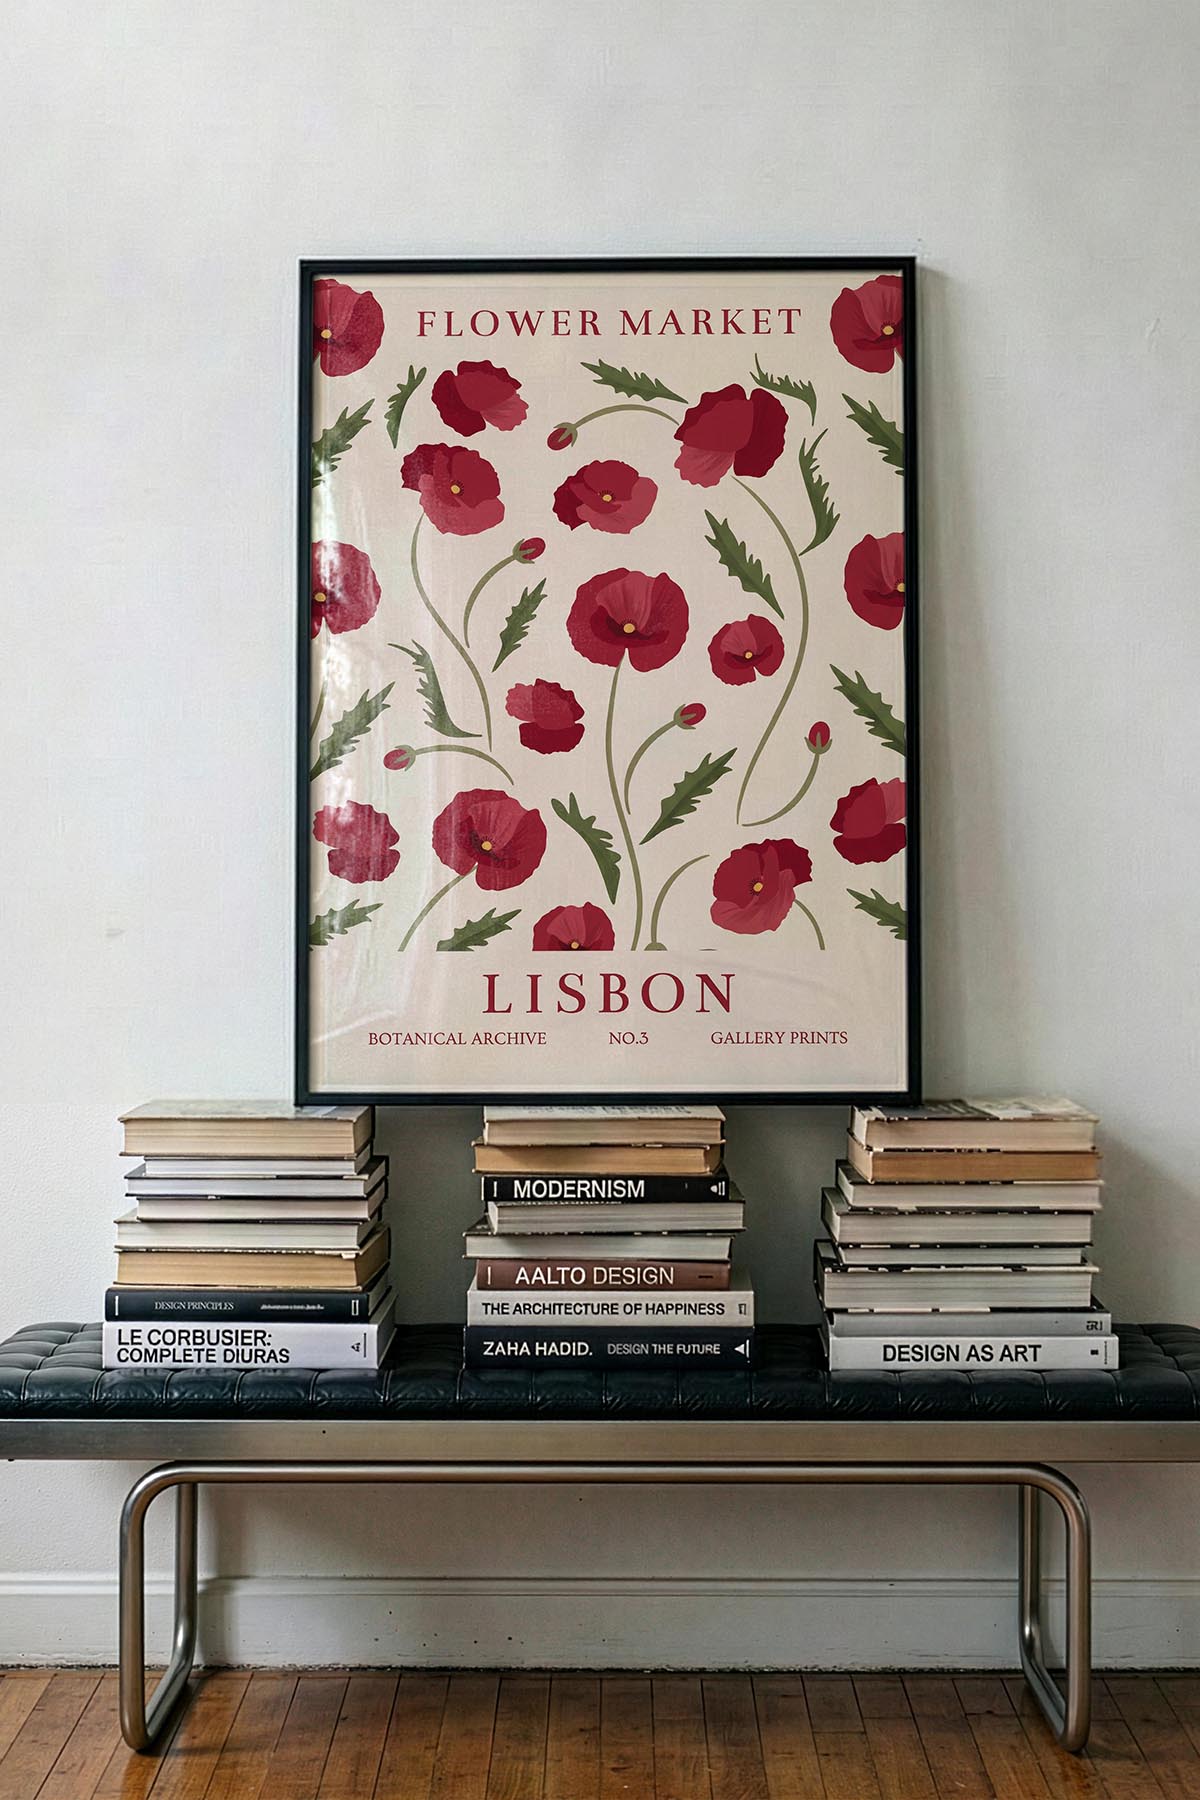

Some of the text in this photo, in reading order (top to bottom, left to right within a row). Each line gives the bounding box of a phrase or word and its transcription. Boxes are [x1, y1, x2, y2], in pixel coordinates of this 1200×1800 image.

[416, 307, 802, 338] FLOWER MARKET
[482, 972, 736, 1015] LISBON
[367, 1030, 547, 1046] BOTANICAL ARCHIVE
[608, 1030, 650, 1046] NO.3
[710, 1030, 849, 1046] GALLERY PRINTS
[513, 1179, 646, 1199] MODERNISM
[515, 1266, 675, 1286] AALTO DESIGN
[153, 1300, 235, 1311] DESIGN PRINCIPLES
[481, 1302, 510, 1317] THE
[512, 1302, 620, 1317] ARCHITECTURE
[623, 1302, 643, 1317] OF
[645, 1302, 726, 1317] HAPPINESS
[117, 1328, 272, 1348] LE CORBUSIER:
[116, 1347, 290, 1364] COMPLETE DIURAS
[482, 1341, 721, 1357] ZAHA HADID. DESIGN THE FUTURE
[882, 1344, 1042, 1363] DESIGN AS ART
